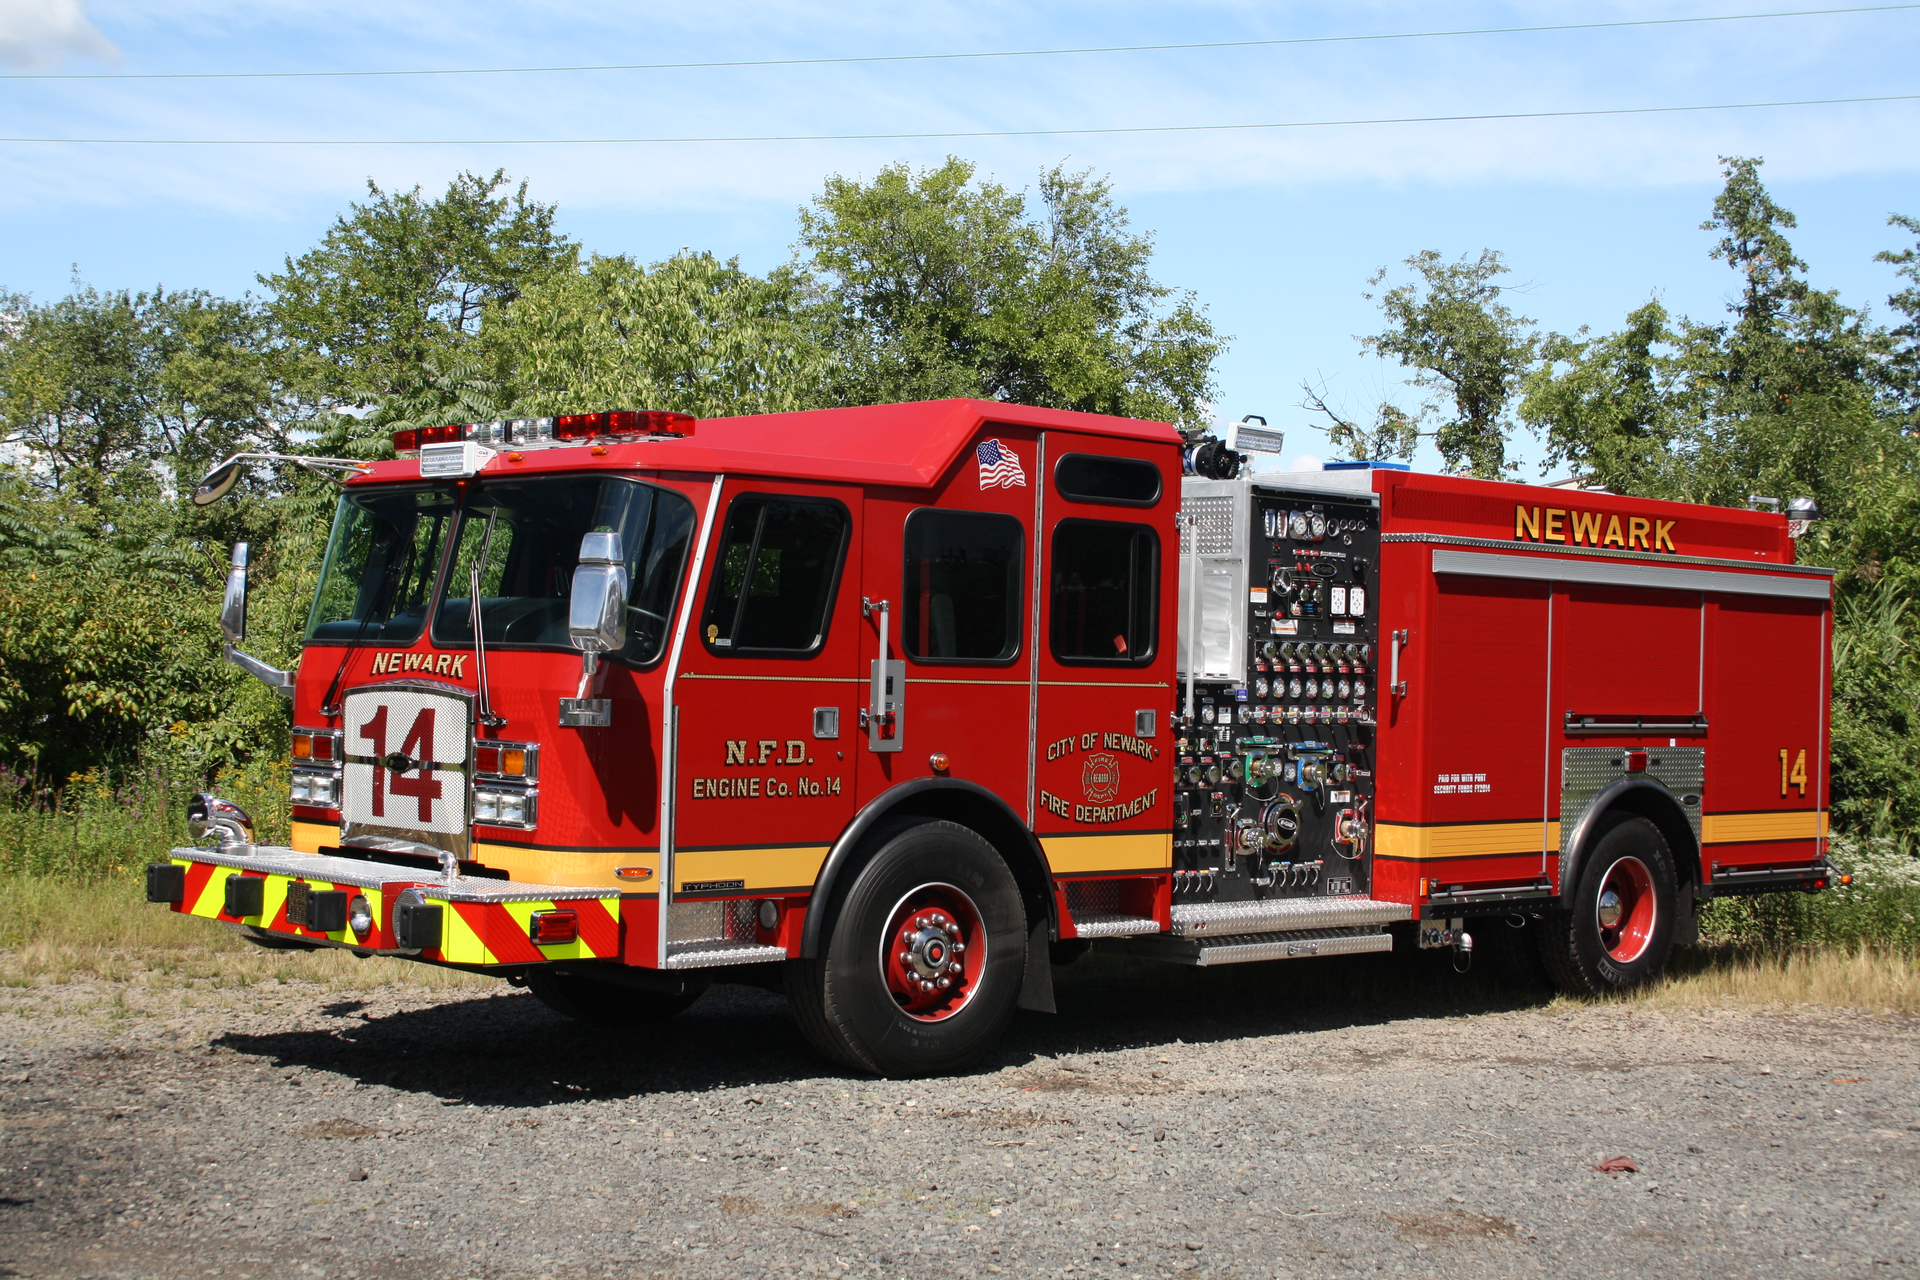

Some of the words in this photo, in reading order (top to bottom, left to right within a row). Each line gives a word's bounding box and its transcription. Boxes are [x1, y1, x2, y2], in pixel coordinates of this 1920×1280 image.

[1515, 504, 1676, 553] NEWARK
[370, 652, 469, 679] NEWARK
[725, 740, 814, 765] N.F.D.
[1047, 735, 1076, 761] CITY
[1081, 732, 1099, 750] OF
[1103, 732, 1153, 762] NEWARK
[360, 705, 442, 823] 14
[1779, 748, 1807, 798] 14
[693, 777, 760, 799] ENGINE
[766, 777, 793, 797] Co.
[1040, 788, 1070, 819] FIRE
[1075, 788, 1158, 824] DEPARTMENT
[684, 881, 744, 891] TYPHOON
